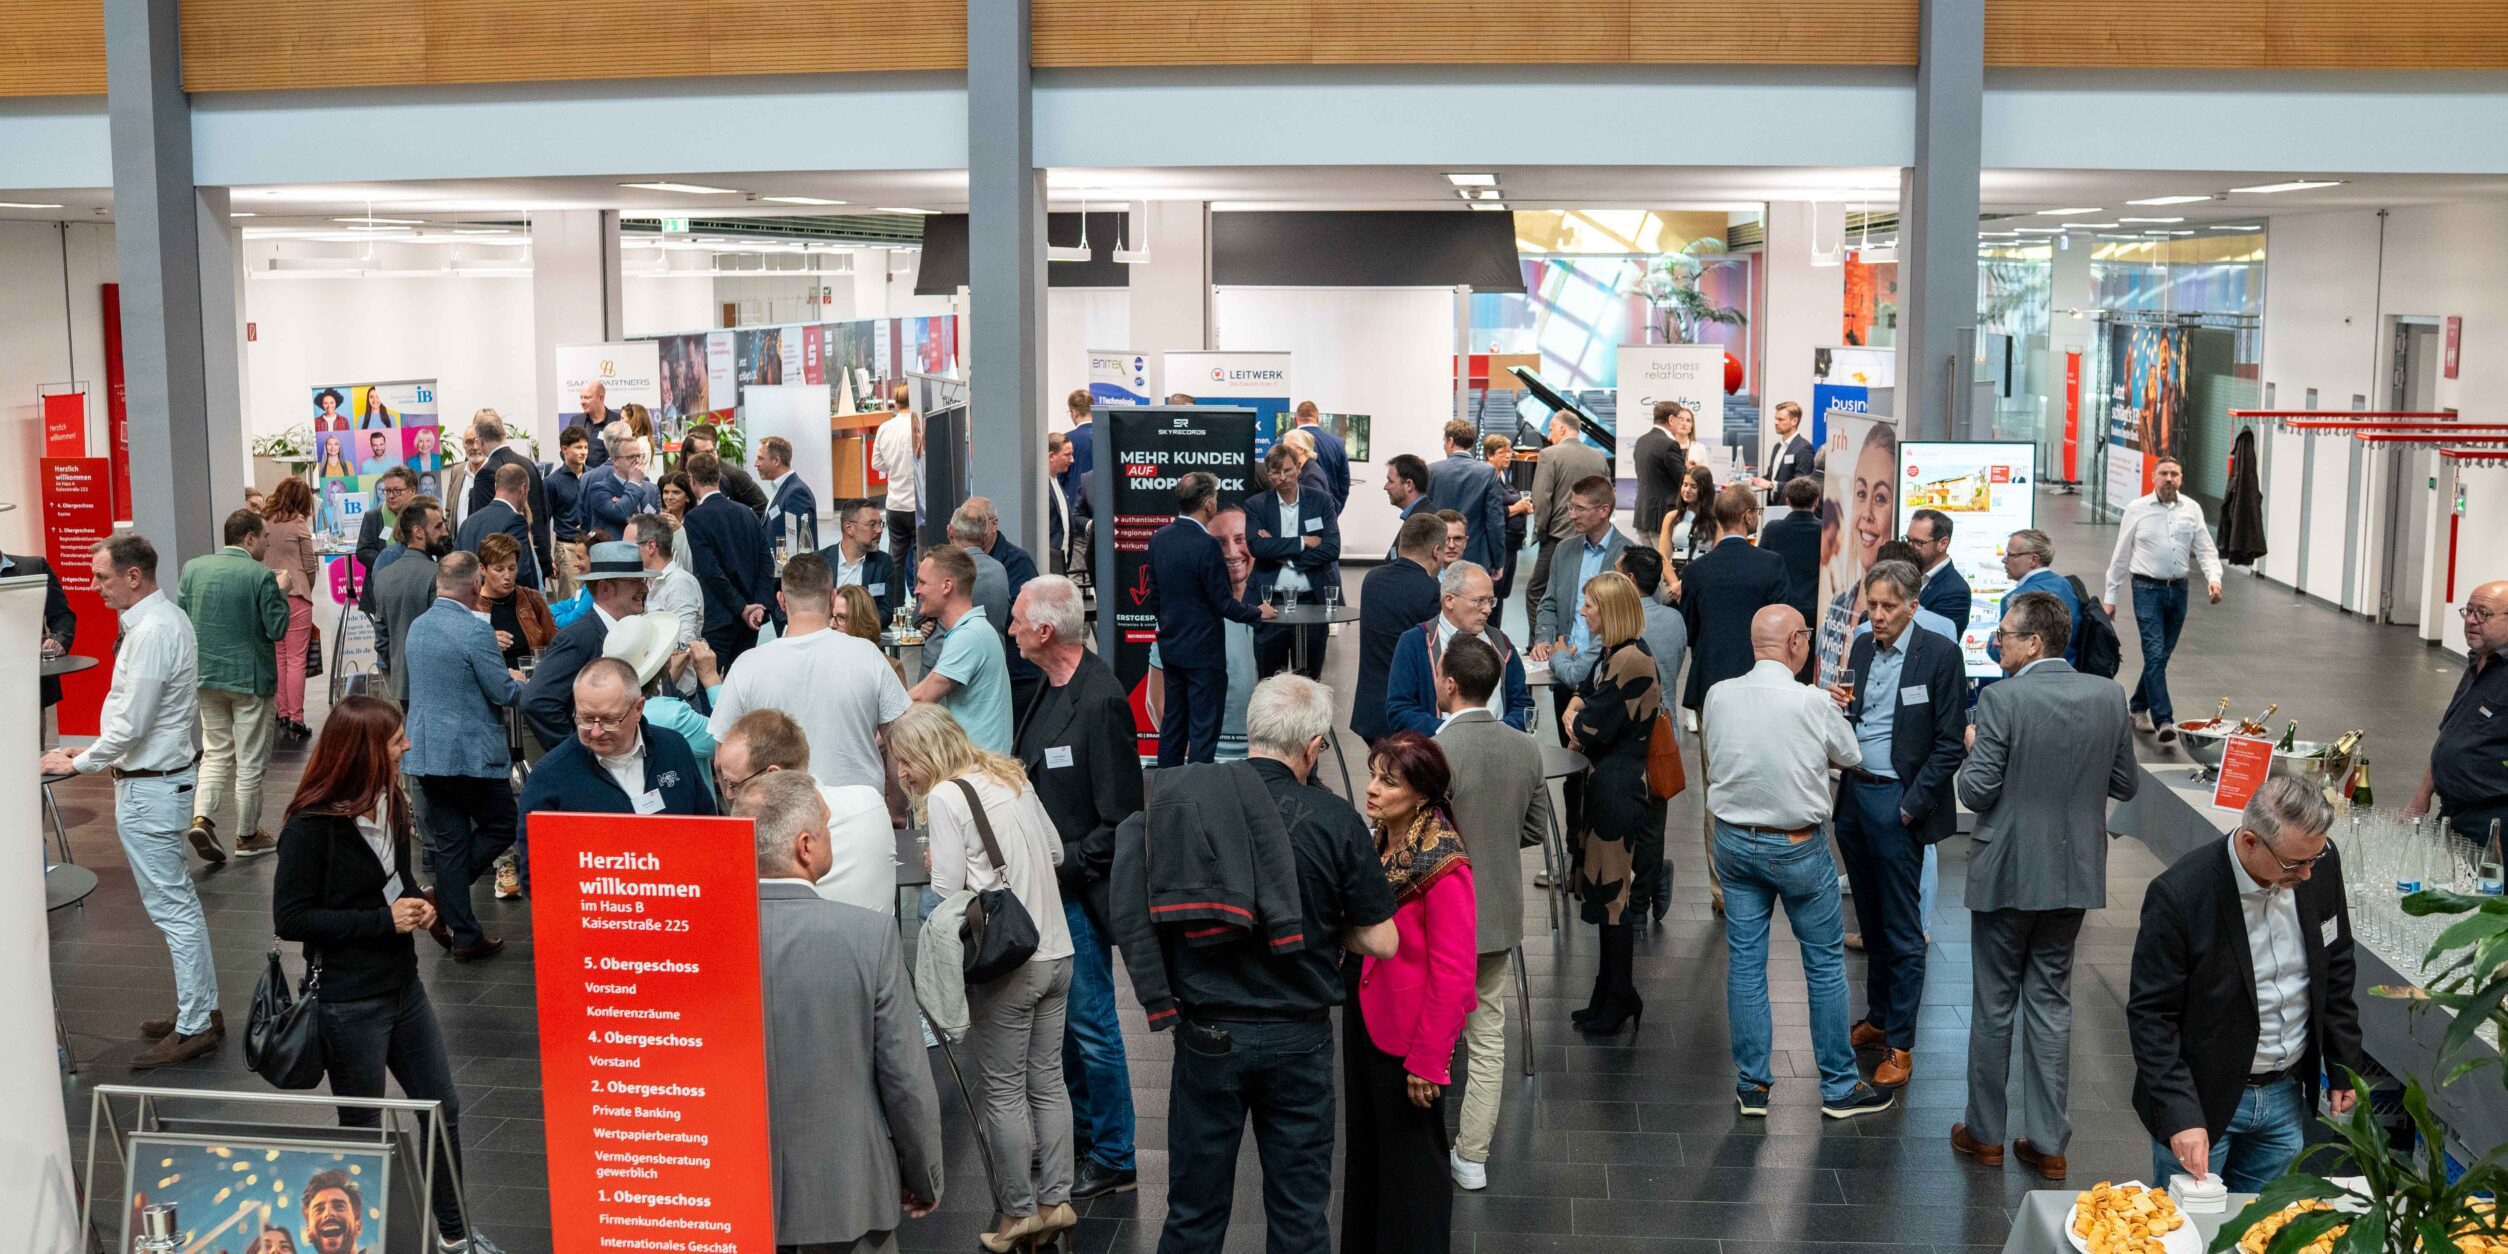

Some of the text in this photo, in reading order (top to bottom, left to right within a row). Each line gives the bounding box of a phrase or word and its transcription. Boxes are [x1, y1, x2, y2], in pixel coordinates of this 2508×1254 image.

[1652, 360, 1700, 371] business
[600, 378, 650, 386] PARTNERS
[1229, 370, 1284, 380] LEITWERK
[1644, 370, 1694, 380] relations
[1640, 396, 1701, 412] Colting
[1832, 396, 1868, 412] busin
[1120, 452, 1169, 464] MEHR
[1174, 452, 1244, 465] KUNDEN
[1128, 466, 1154, 476] AUF
[579, 852, 659, 870] Herzlich
[580, 877, 700, 897] willkommen
[581, 900, 644, 912] im Haus B
[582, 917, 689, 931] Kaiserstraße 225
[585, 957, 699, 973] 5. Obergeschoss
[585, 983, 636, 994] Vorstand
[587, 1007, 680, 1020] Konferenzräume
[588, 1031, 702, 1047] 4. Obergeschoss
[589, 1056, 640, 1067] Vorstand
[592, 1080, 705, 1097] 2. Obergeschoss
[593, 1105, 680, 1121] Private Banking
[594, 1128, 708, 1145] Wertpapierberatung
[595, 1151, 710, 1167] Vermögensberatung
[597, 1166, 657, 1178] gewerblich
[599, 1190, 711, 1207] 1. Obergeschoss
[600, 1214, 731, 1233] Firmenkundenberatung
[601, 1237, 737, 1254] Internationales Geschäft
